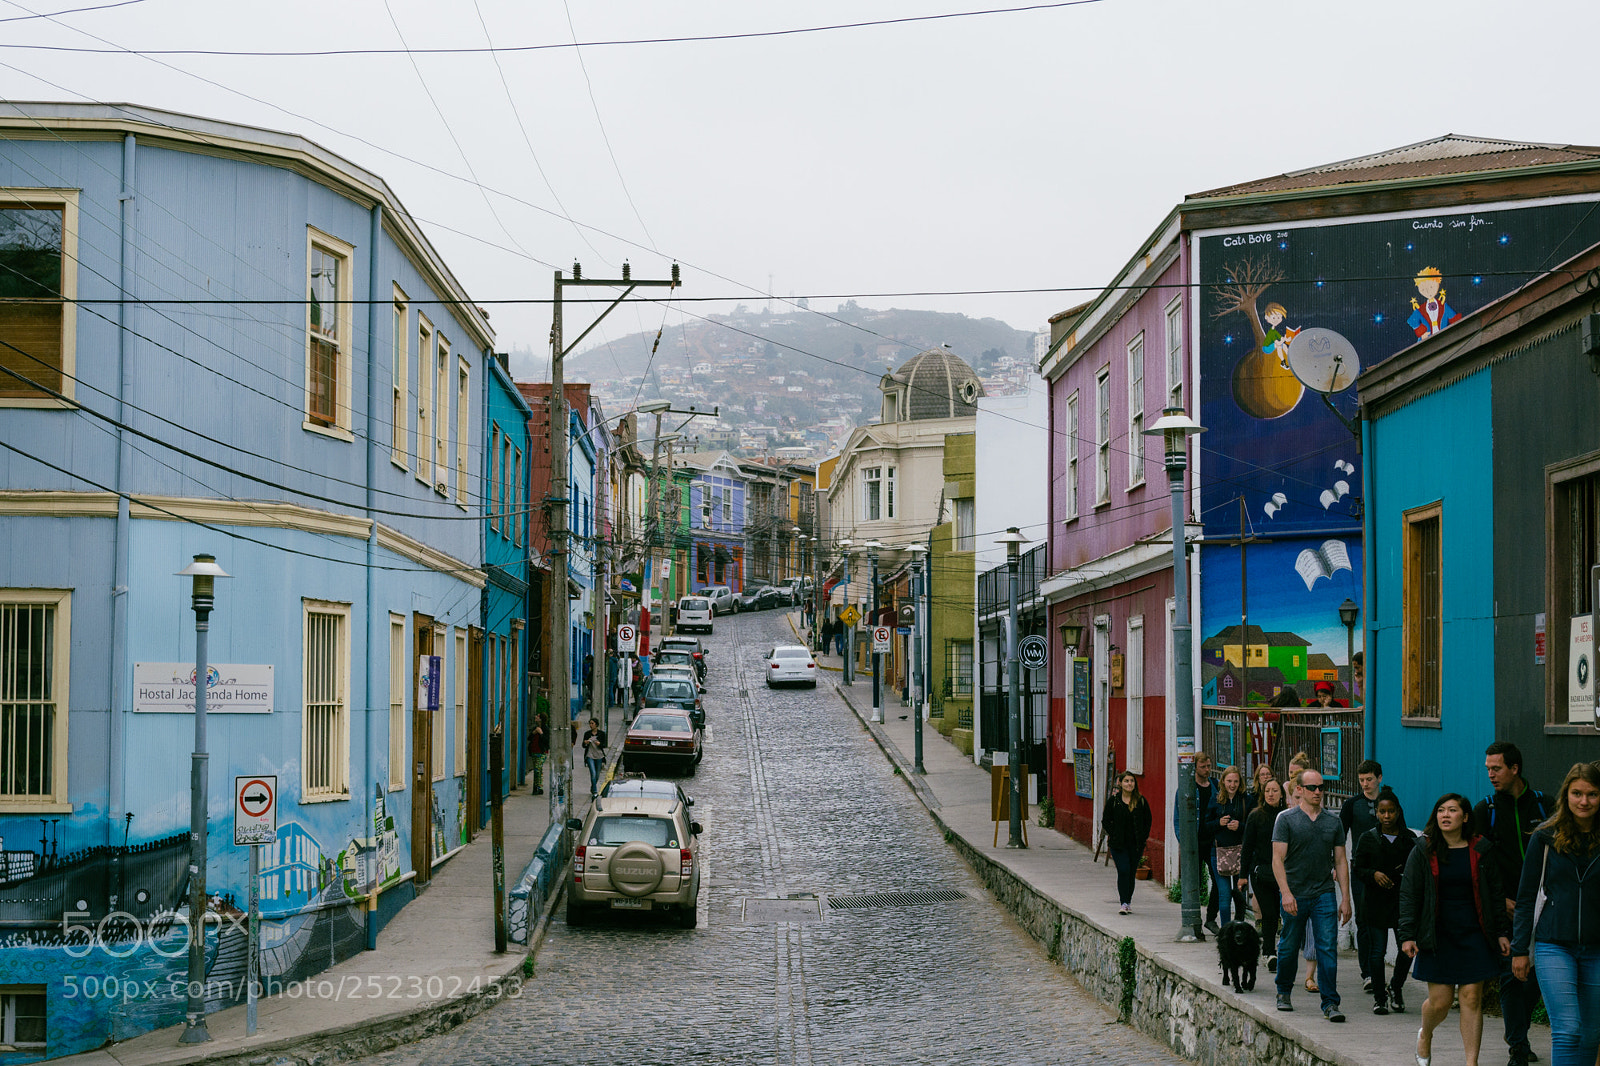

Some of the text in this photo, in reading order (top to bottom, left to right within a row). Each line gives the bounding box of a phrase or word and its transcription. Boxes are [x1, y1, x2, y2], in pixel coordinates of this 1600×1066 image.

[1412, 219, 1443, 230] Cuento
[1449, 220, 1466, 228] sin
[1580, 621, 1588, 633] YES
[139, 688, 268, 700] Hostal Jacanda Home
[615, 867, 657, 876] SUZUKI
